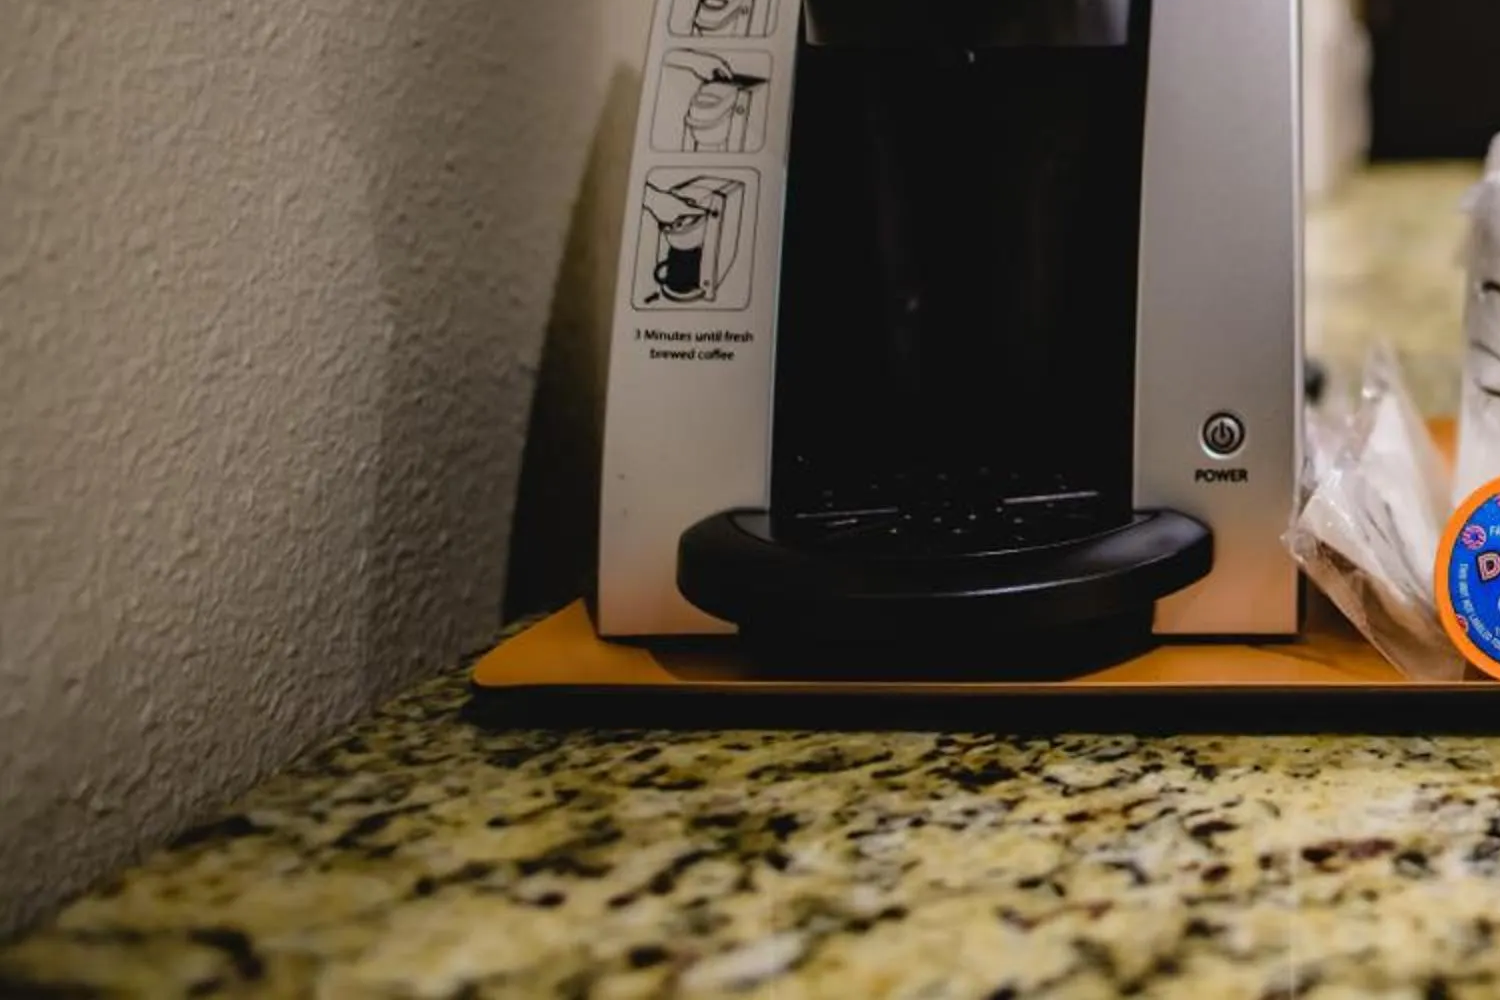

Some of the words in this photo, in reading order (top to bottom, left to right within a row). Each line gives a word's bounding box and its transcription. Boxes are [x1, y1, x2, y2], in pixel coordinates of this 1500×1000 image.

[644, 329, 691, 341] Minutes
[696, 330, 722, 342] until
[724, 330, 754, 343] fresh
[649, 347, 695, 360] brewed
[698, 348, 735, 361] coffee
[1195, 468, 1248, 483] POWER
